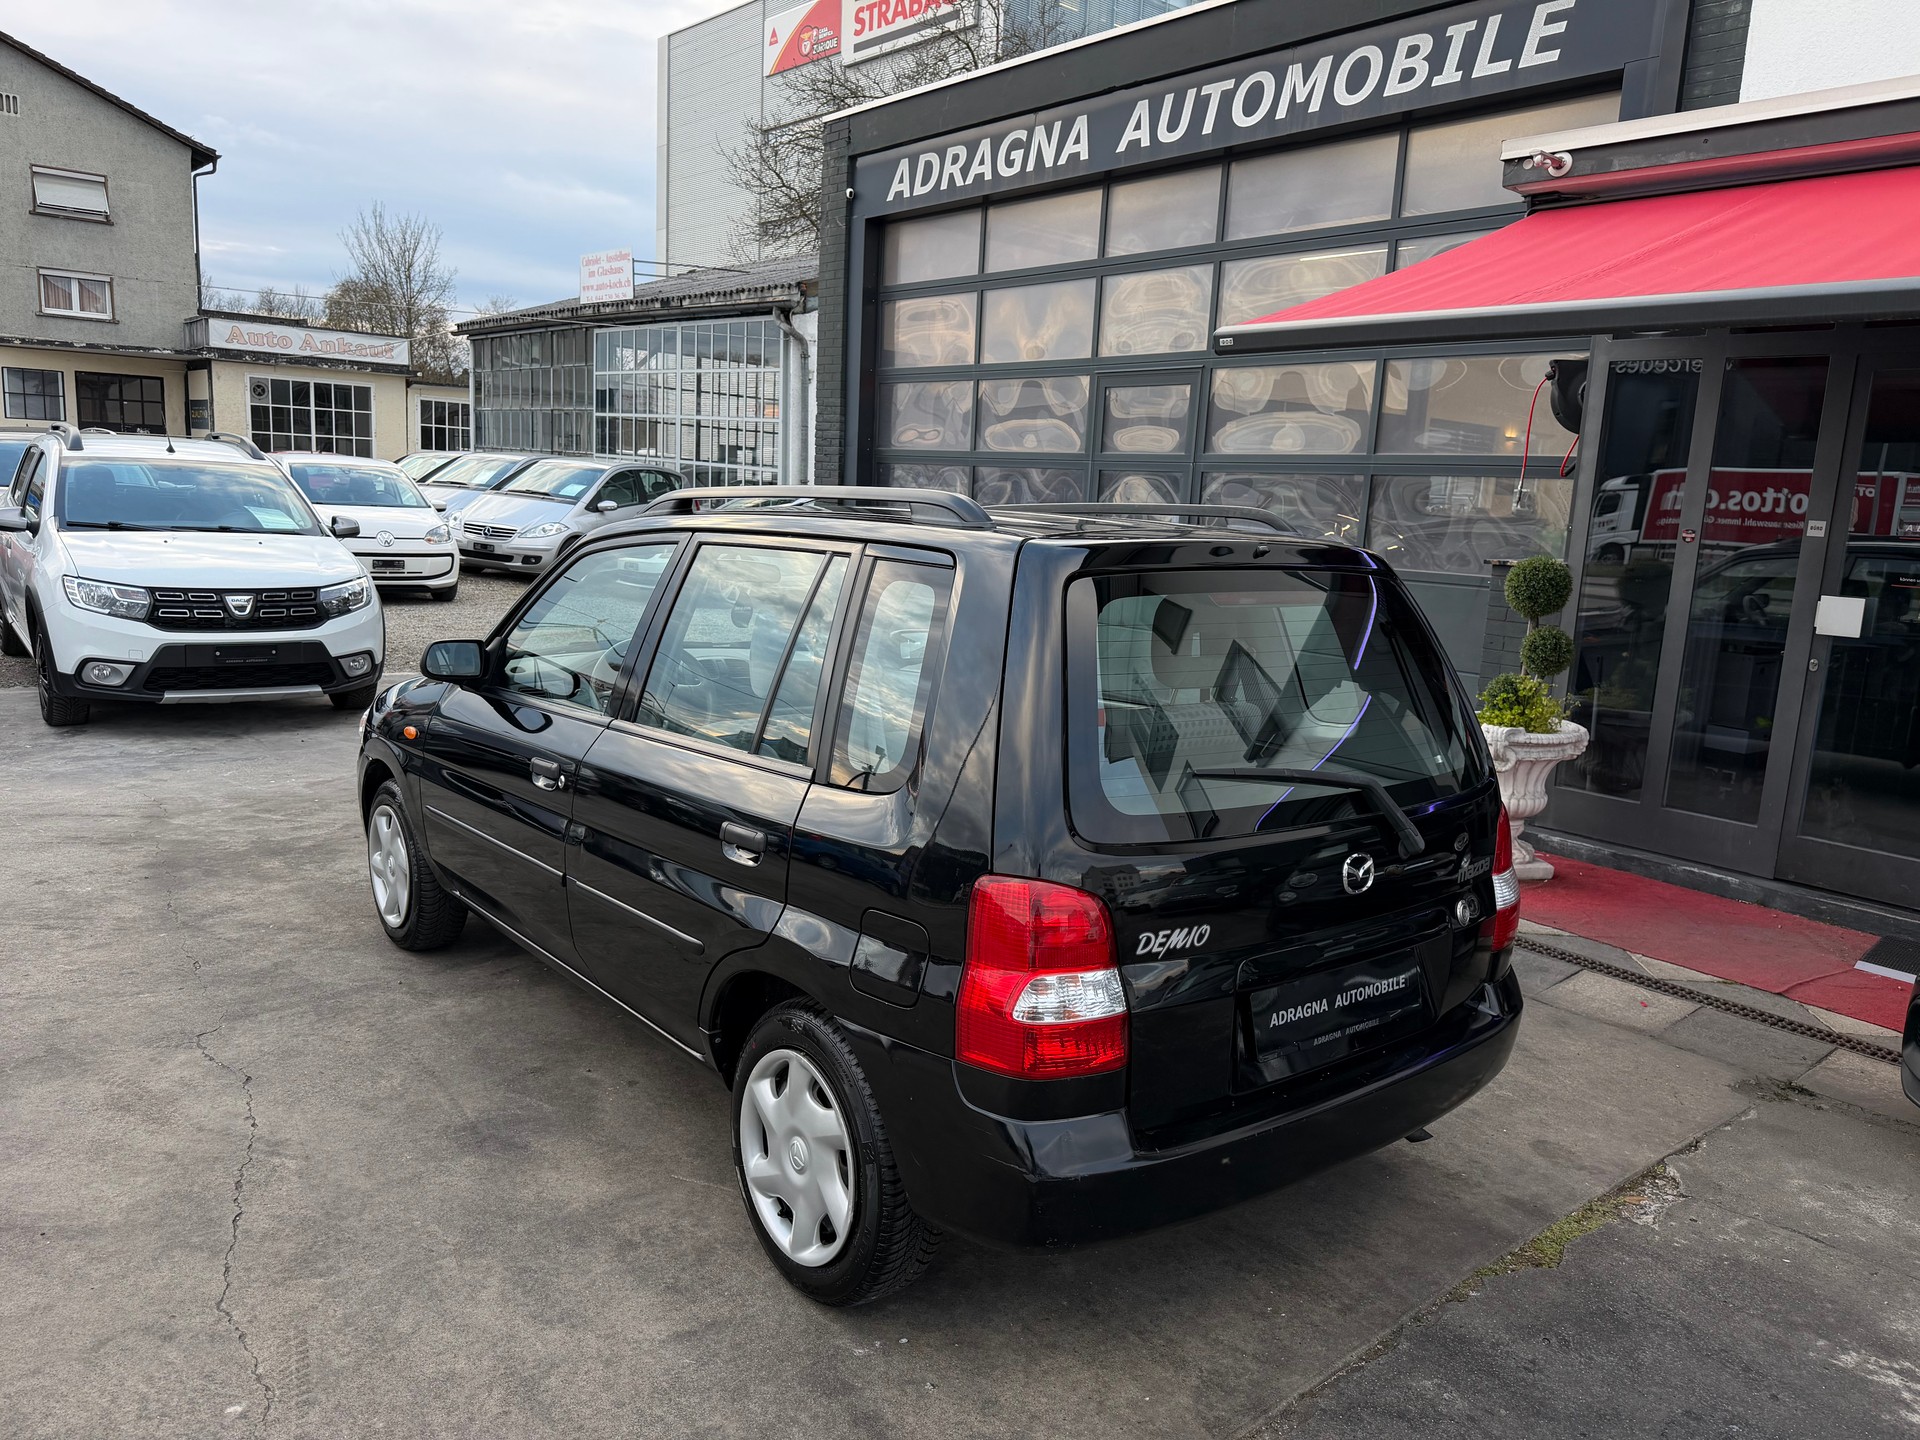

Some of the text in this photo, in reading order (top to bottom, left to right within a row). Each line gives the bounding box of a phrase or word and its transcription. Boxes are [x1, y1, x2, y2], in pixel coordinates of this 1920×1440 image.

[854, 0, 957, 36] STRAB
[887, 0, 1576, 201] ADRAGNA AUTOMOBILE
[597, 265, 624, 277] Glashaus
[225, 325, 395, 360] Auto Ankauf
[1136, 924, 1211, 960] DEMIO
[1270, 975, 1406, 1028] ADRAGNA AUTOMOBILE
[1313, 1018, 1380, 1046] ADRAGNA AUTOMOBILE
